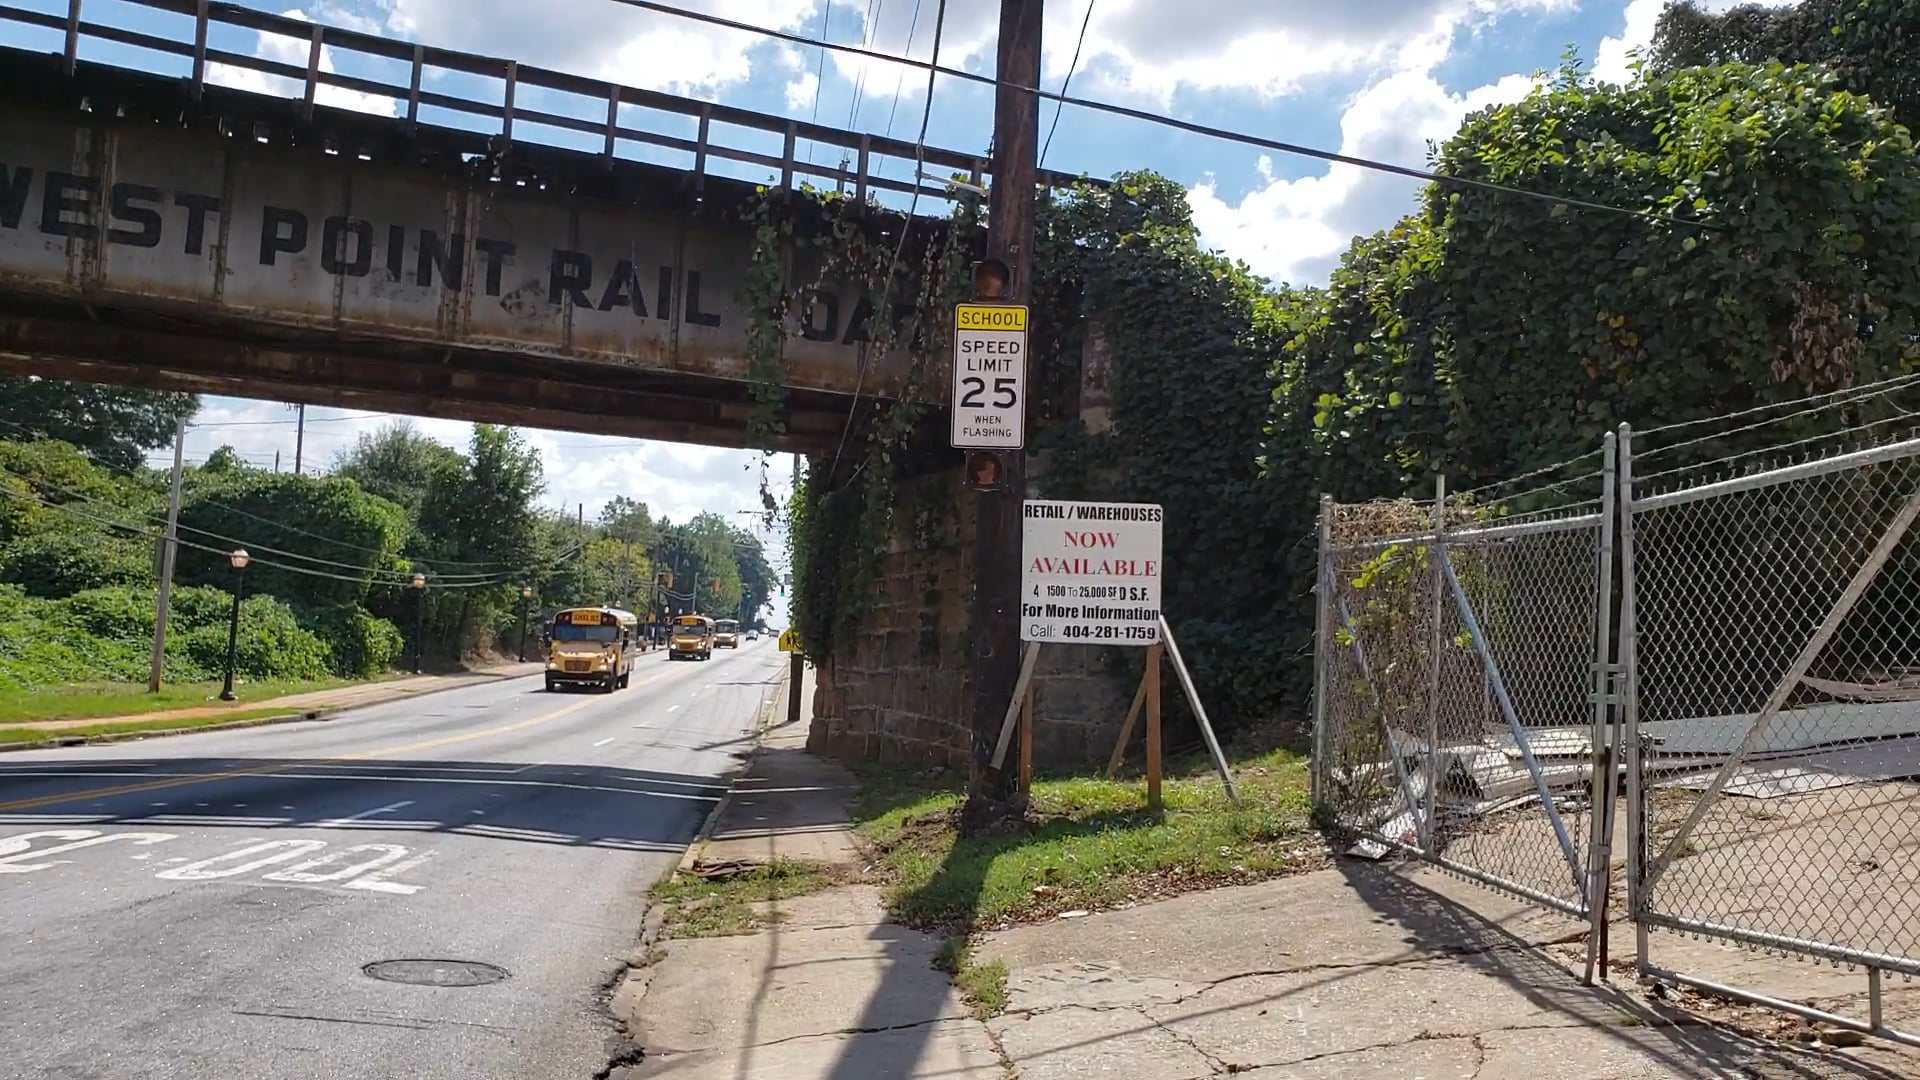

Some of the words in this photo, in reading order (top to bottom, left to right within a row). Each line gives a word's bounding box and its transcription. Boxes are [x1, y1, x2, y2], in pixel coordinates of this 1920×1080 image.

[259, 204, 517, 297] POINT
[960, 311, 1023, 327] SCHOOL
[961, 340, 1020, 354] SPEED
[967, 359, 1012, 372] LIMIT
[959, 376, 1018, 409] 25
[974, 415, 1002, 425] WHEN
[962, 427, 1012, 438] FLASHING
[1024, 504, 1065, 519] RETAIL
[1076, 506, 1162, 522] WAREHOUSES
[1063, 531, 1120, 549] NOW
[1028, 557, 1157, 577] AVAILABLE
[1047, 585, 1066, 597] 1500
[1129, 587, 1149, 602] S.F.
[1022, 603, 1043, 617] For
[1046, 604, 1079, 618] More
[1082, 605, 1159, 621] Information
[1030, 624, 1056, 638] Call:
[1062, 625, 1156, 640] 404-281-1759
[0, 829, 440, 895] SCOOL
